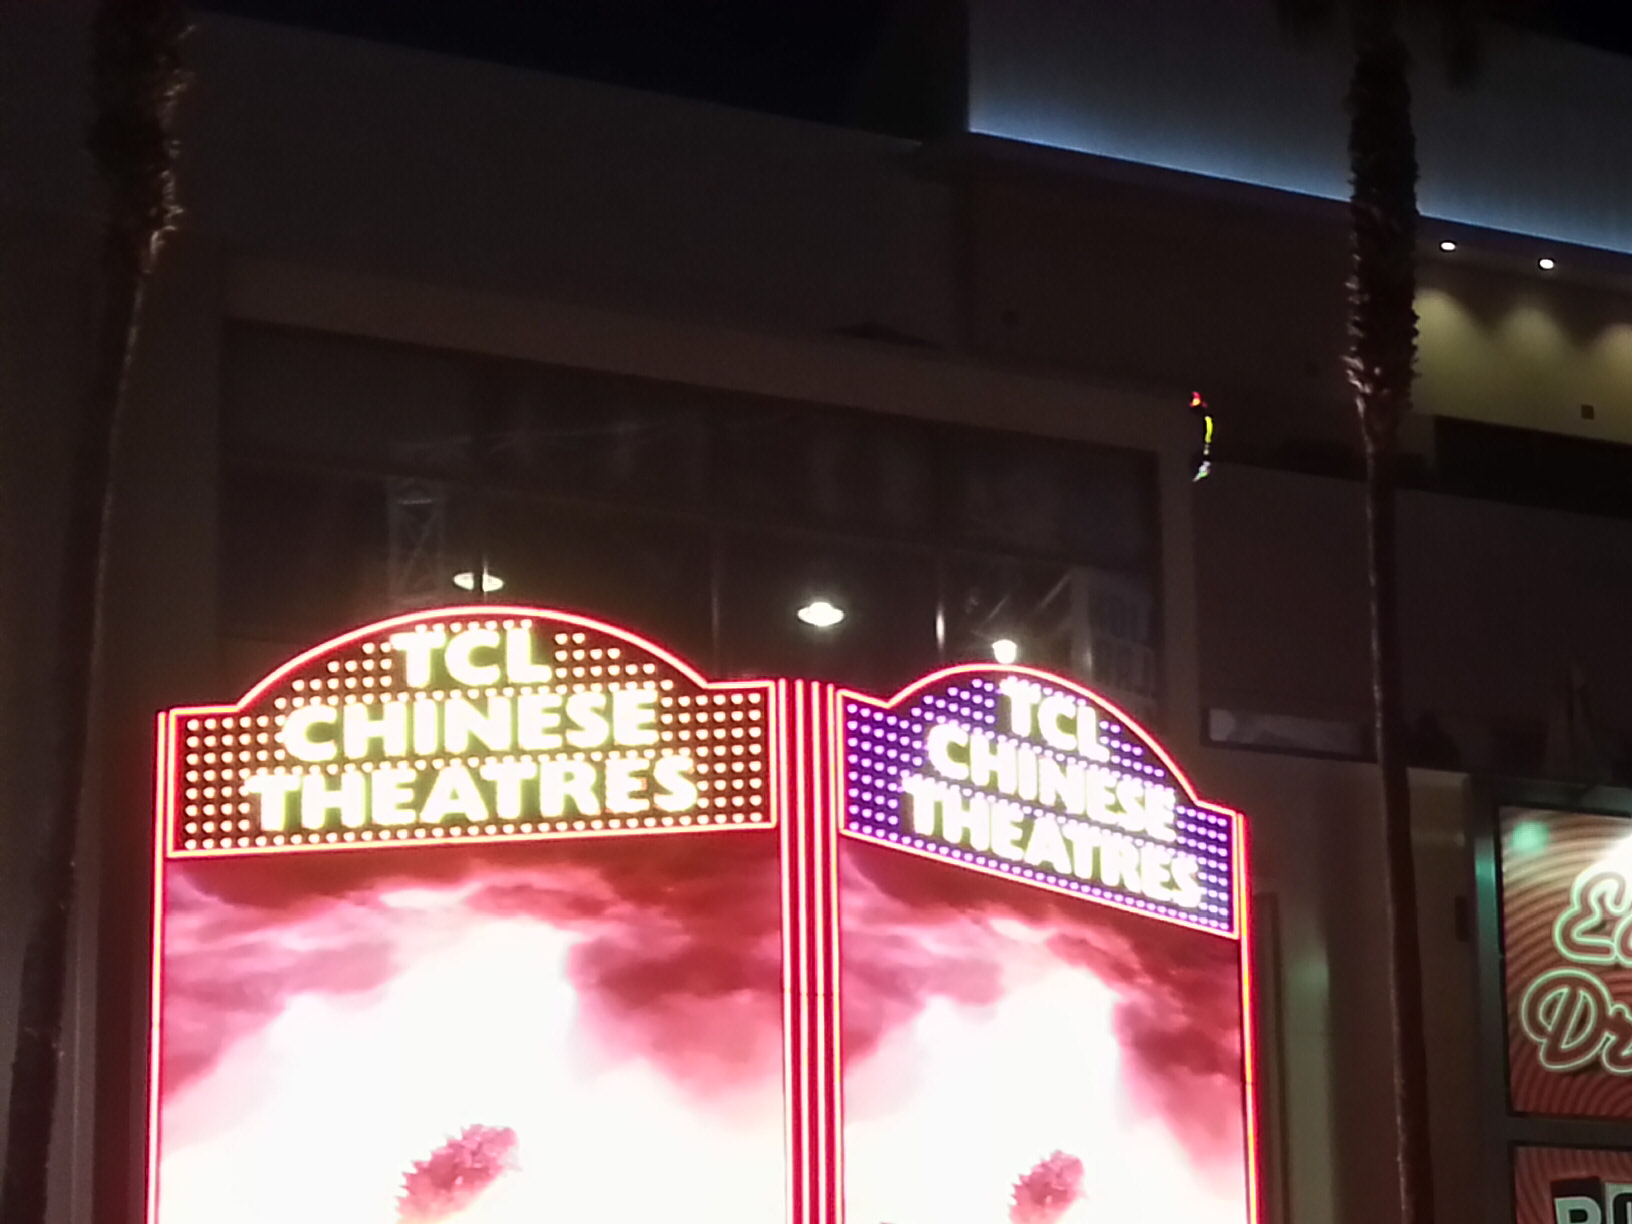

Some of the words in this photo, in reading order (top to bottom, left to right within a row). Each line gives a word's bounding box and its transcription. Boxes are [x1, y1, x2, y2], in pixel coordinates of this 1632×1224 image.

[389, 630, 551, 687] TCL
[281, 690, 659, 762] CHINESE
[1000, 677, 1110, 762] TCL
[244, 757, 699, 831] THEATRES
[927, 722, 1177, 842] CHINESE
[902, 774, 1200, 908] THEATRES
